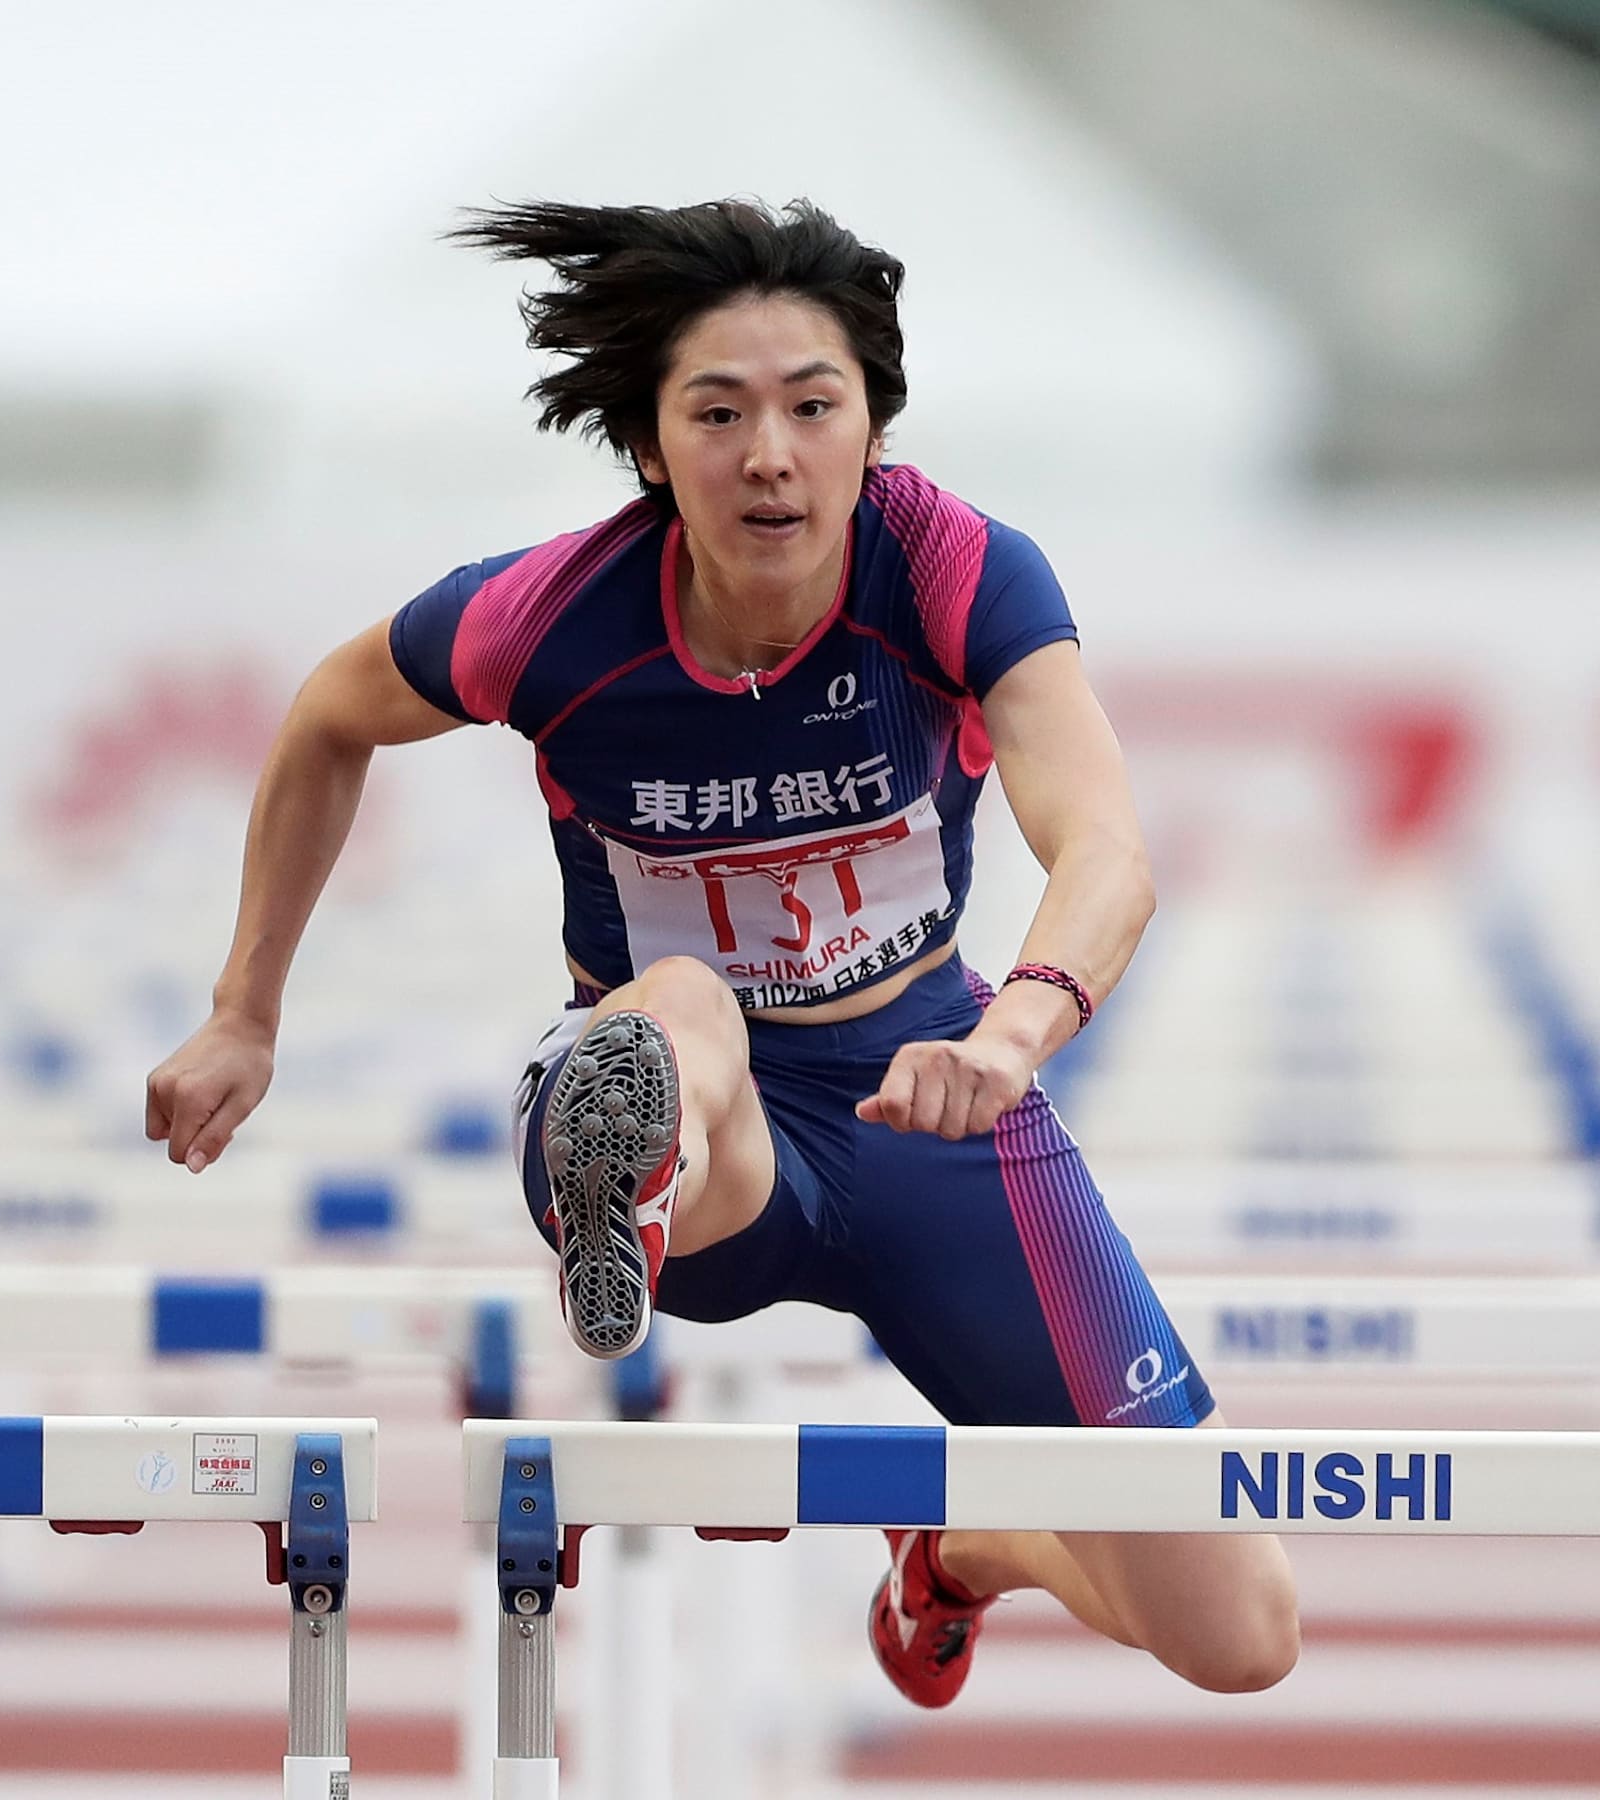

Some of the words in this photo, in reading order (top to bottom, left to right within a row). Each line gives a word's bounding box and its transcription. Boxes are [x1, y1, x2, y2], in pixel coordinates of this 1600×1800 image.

[726, 925, 871, 981] SHIMURA
[834, 908, 946, 991] 日本選手権
[1220, 1451, 1452, 1521] NISHI
